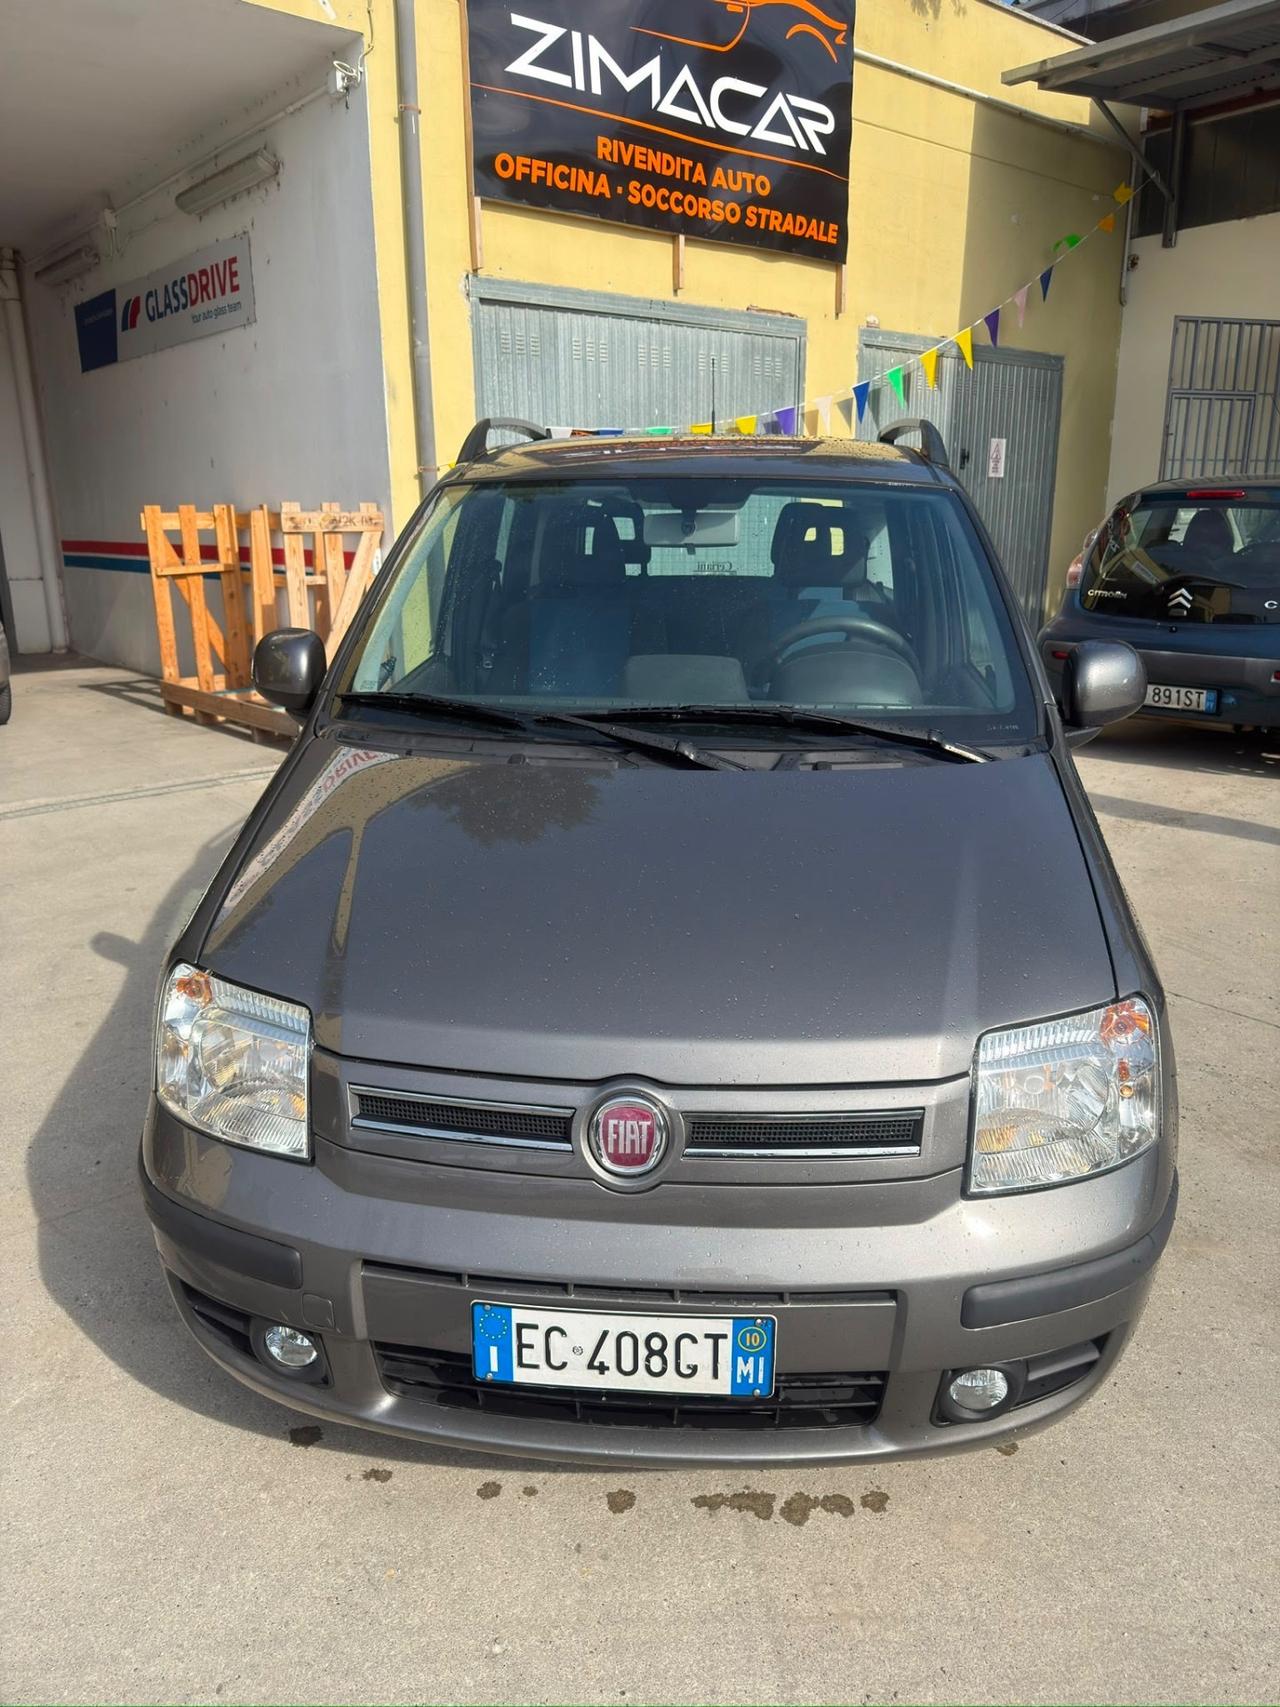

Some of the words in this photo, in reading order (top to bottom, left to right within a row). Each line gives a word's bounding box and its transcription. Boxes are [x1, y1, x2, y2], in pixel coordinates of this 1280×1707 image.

[504, 13, 836, 156] ZIMACAR
[596, 136, 707, 186] RIVENDITA
[711, 167, 772, 197] AUTO
[495, 153, 611, 199] OFFICINA
[627, 181, 742, 225] SOCCORSO
[745, 205, 839, 245] STRADALE
[145, 256, 240, 322] GLASSDRIVE
[1152, 687, 1204, 709] 891ST
[607, 1119, 652, 1154] FIAT
[515, 1322, 568, 1371] EC
[587, 1329, 728, 1380] 408GT
[746, 1333, 760, 1347] 10
[736, 1356, 765, 1384] MI
